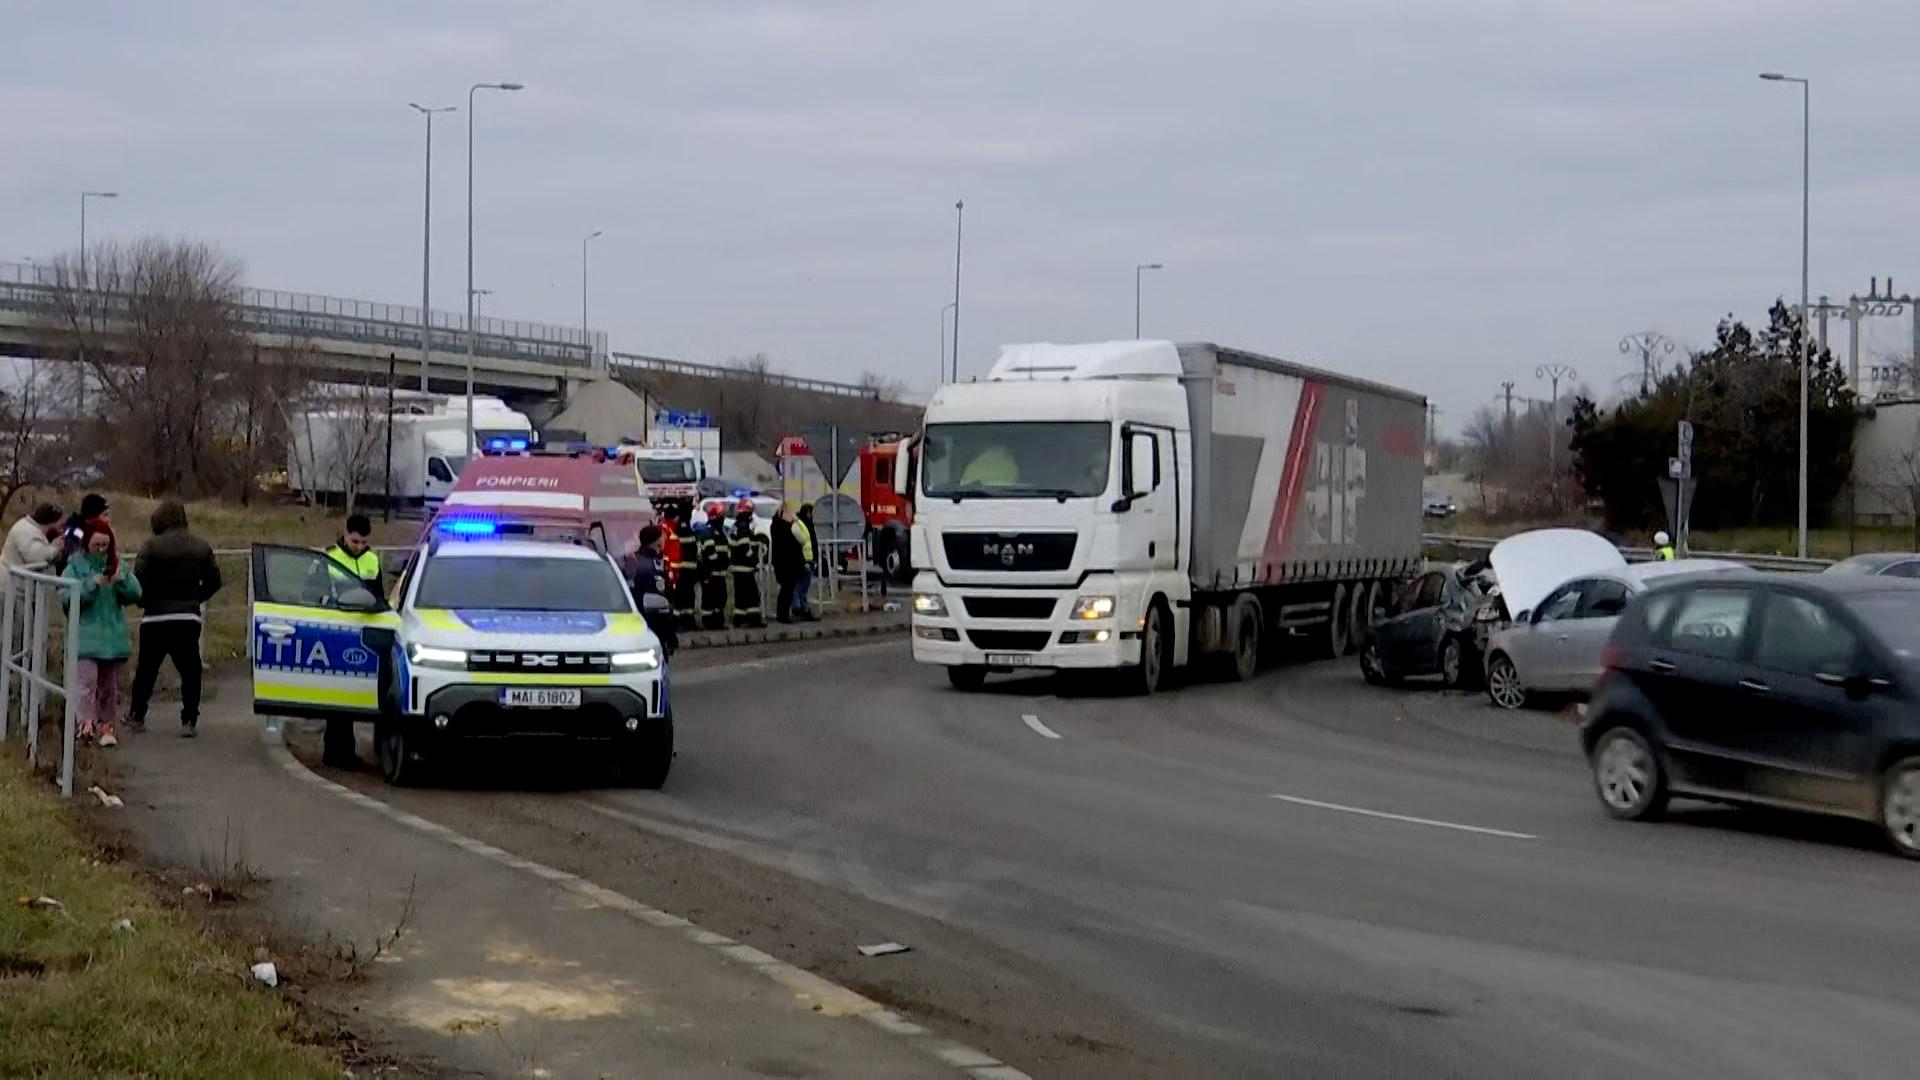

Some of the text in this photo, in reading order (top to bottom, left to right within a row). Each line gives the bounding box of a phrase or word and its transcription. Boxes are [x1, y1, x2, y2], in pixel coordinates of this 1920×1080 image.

[476, 476, 559, 487] POMPIERII
[983, 543, 1034, 555] MAN
[511, 691, 576, 704] MAI 61802
